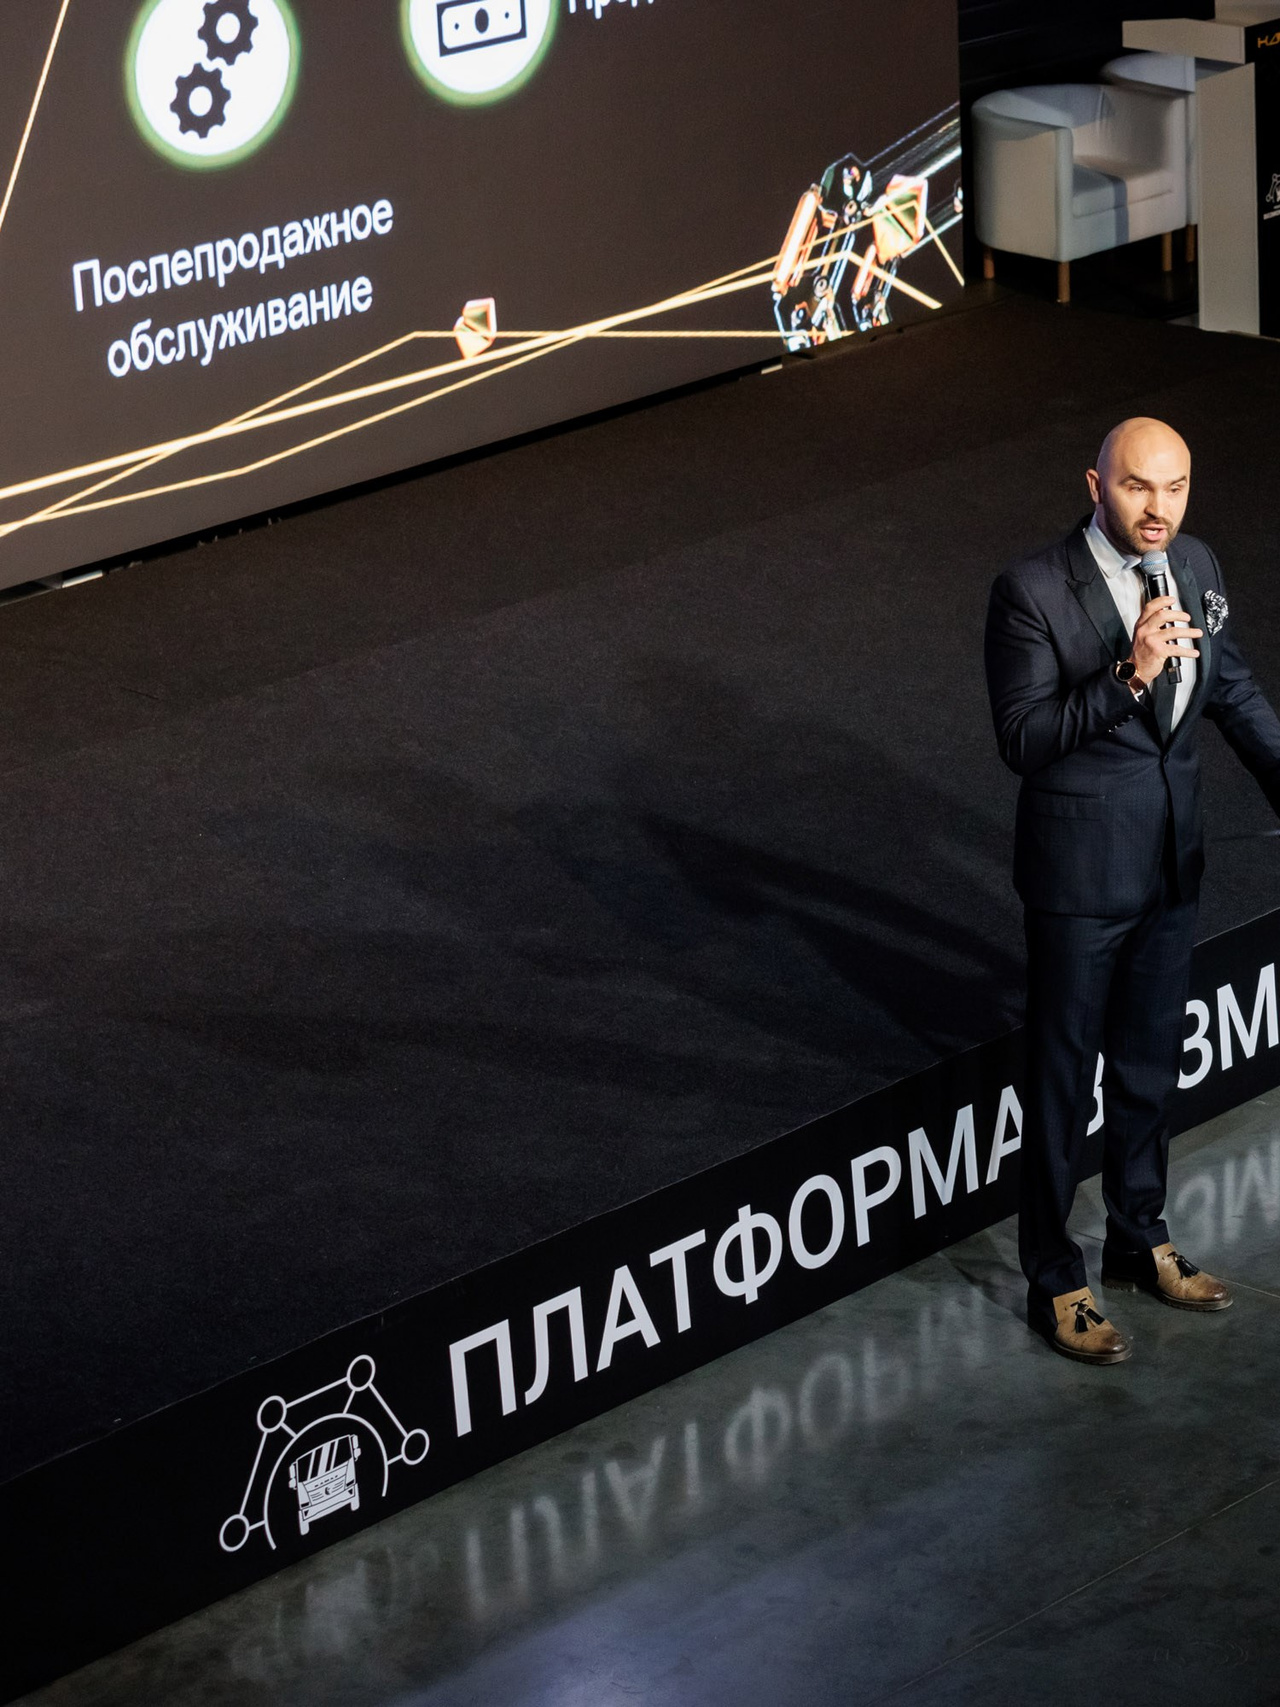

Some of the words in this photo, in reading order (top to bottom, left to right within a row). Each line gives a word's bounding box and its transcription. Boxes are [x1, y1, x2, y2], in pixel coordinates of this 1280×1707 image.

[72, 199, 394, 311] Послепродажное
[107, 275, 373, 378] обслуживание
[449, 1084, 1023, 1437] ПЛАТФОРМА
